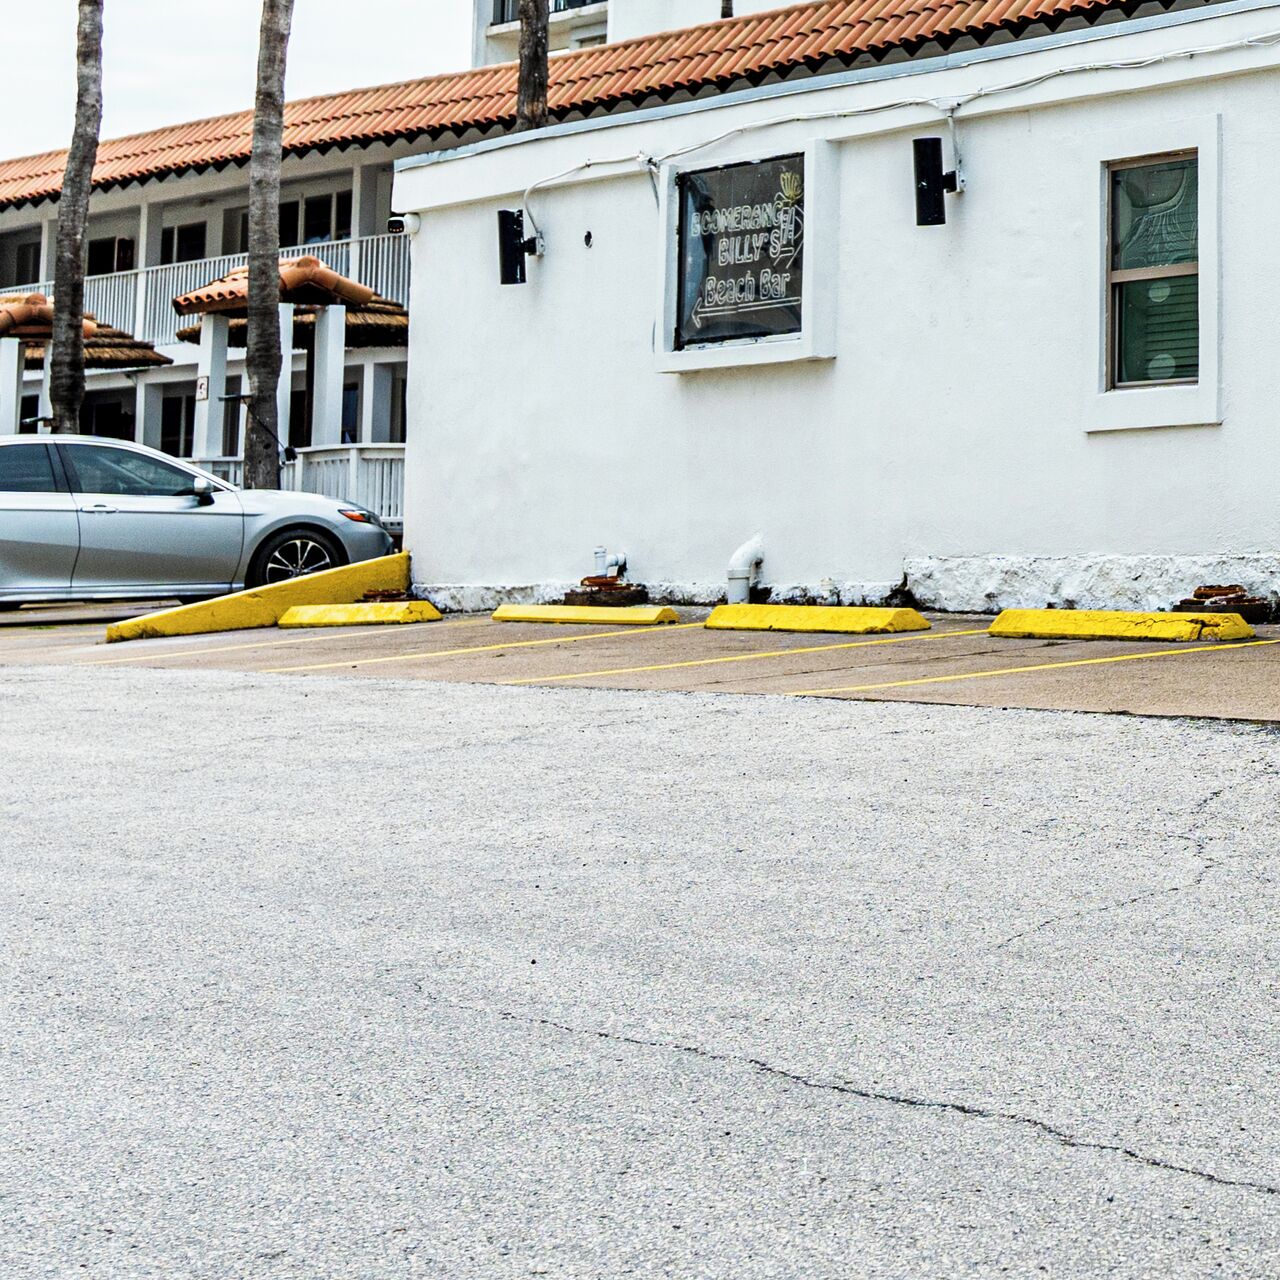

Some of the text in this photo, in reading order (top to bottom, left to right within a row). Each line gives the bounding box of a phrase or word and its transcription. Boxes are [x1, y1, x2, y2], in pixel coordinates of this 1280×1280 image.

[691, 200, 784, 237] BOOMERANG
[718, 229, 781, 266] BILLY'S
[705, 268, 791, 306] Beach Bar
